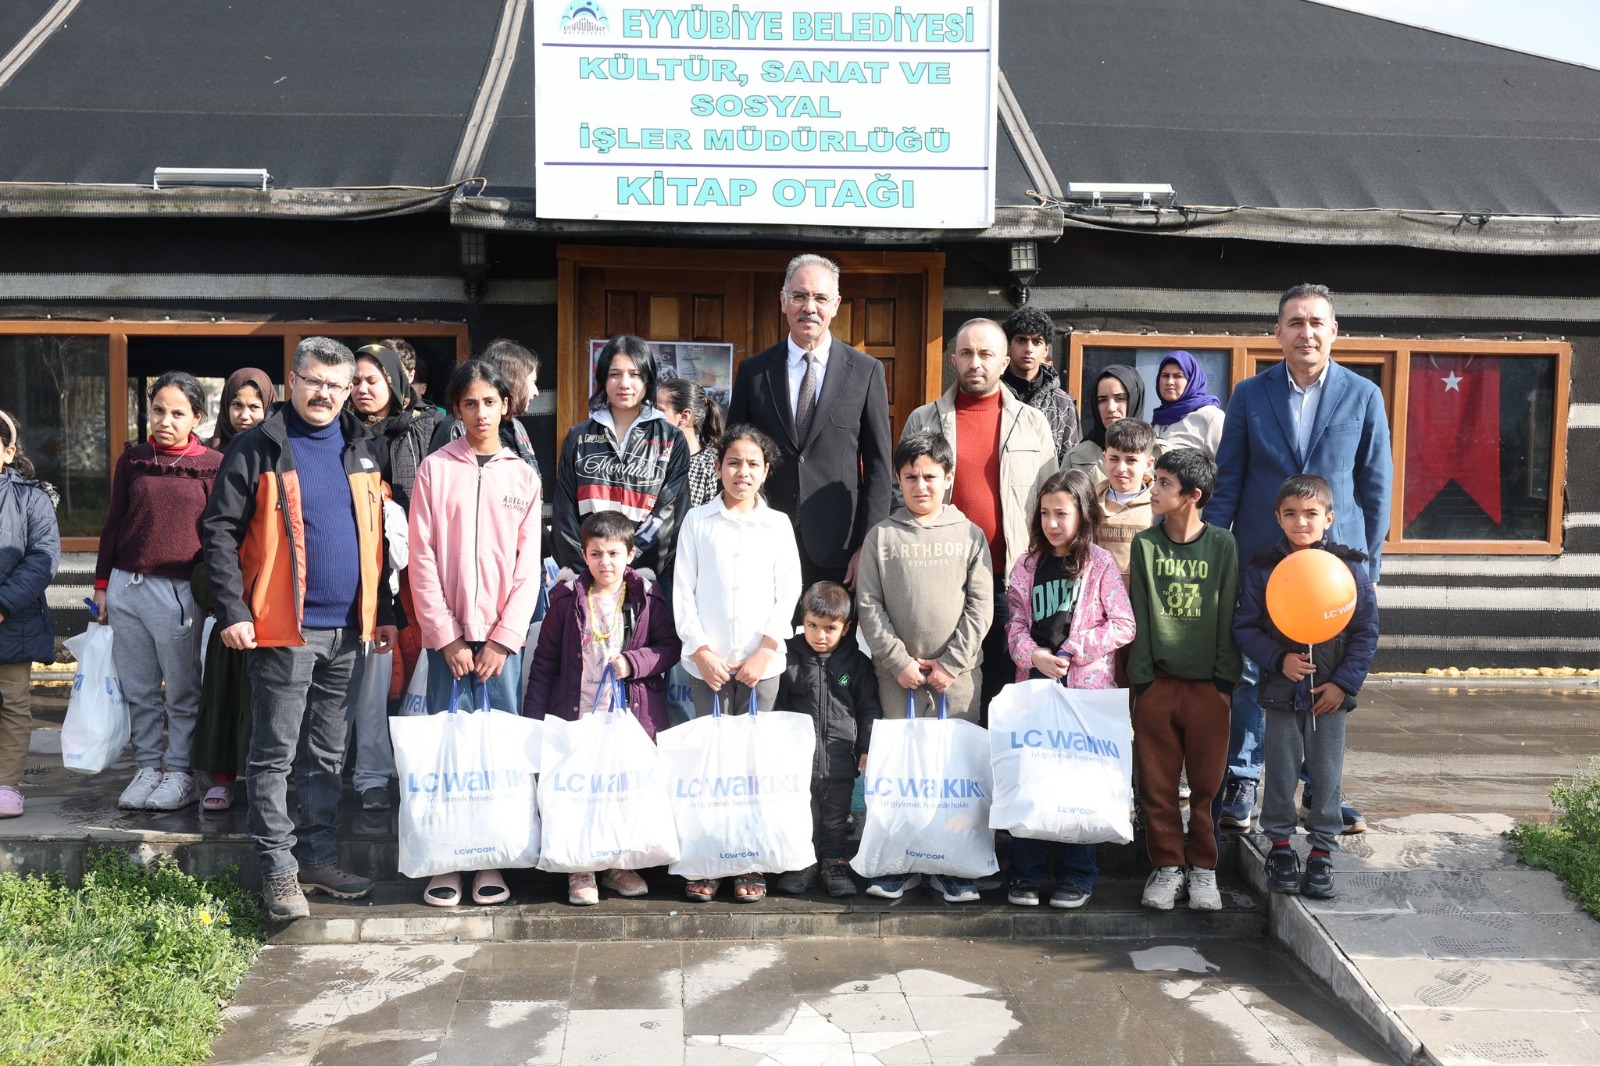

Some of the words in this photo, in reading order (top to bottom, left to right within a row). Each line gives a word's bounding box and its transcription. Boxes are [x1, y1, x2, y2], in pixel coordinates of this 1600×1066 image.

[623, 3, 783, 41] EYYÜBİYE
[792, 5, 974, 42] BELEDİYESİ
[579, 53, 748, 87] KÜLTÜR,
[761, 59, 889, 84] SANAT
[899, 61, 951, 84] VE
[690, 94, 841, 118] SOSYAL
[579, 122, 693, 154] İŞLER
[704, 126, 951, 153] MÜDÜRLÜĞÜ
[616, 171, 757, 207] KİTAP
[772, 173, 915, 209] OTAĞI
[1156, 558, 1208, 579] TOKYO
[1167, 582, 1199, 609] 87
[1160, 606, 1201, 617] J.A.P.A.N
[1010, 729, 1043, 749] LC
[553, 772, 585, 792] LC
[676, 778, 702, 798] LC
